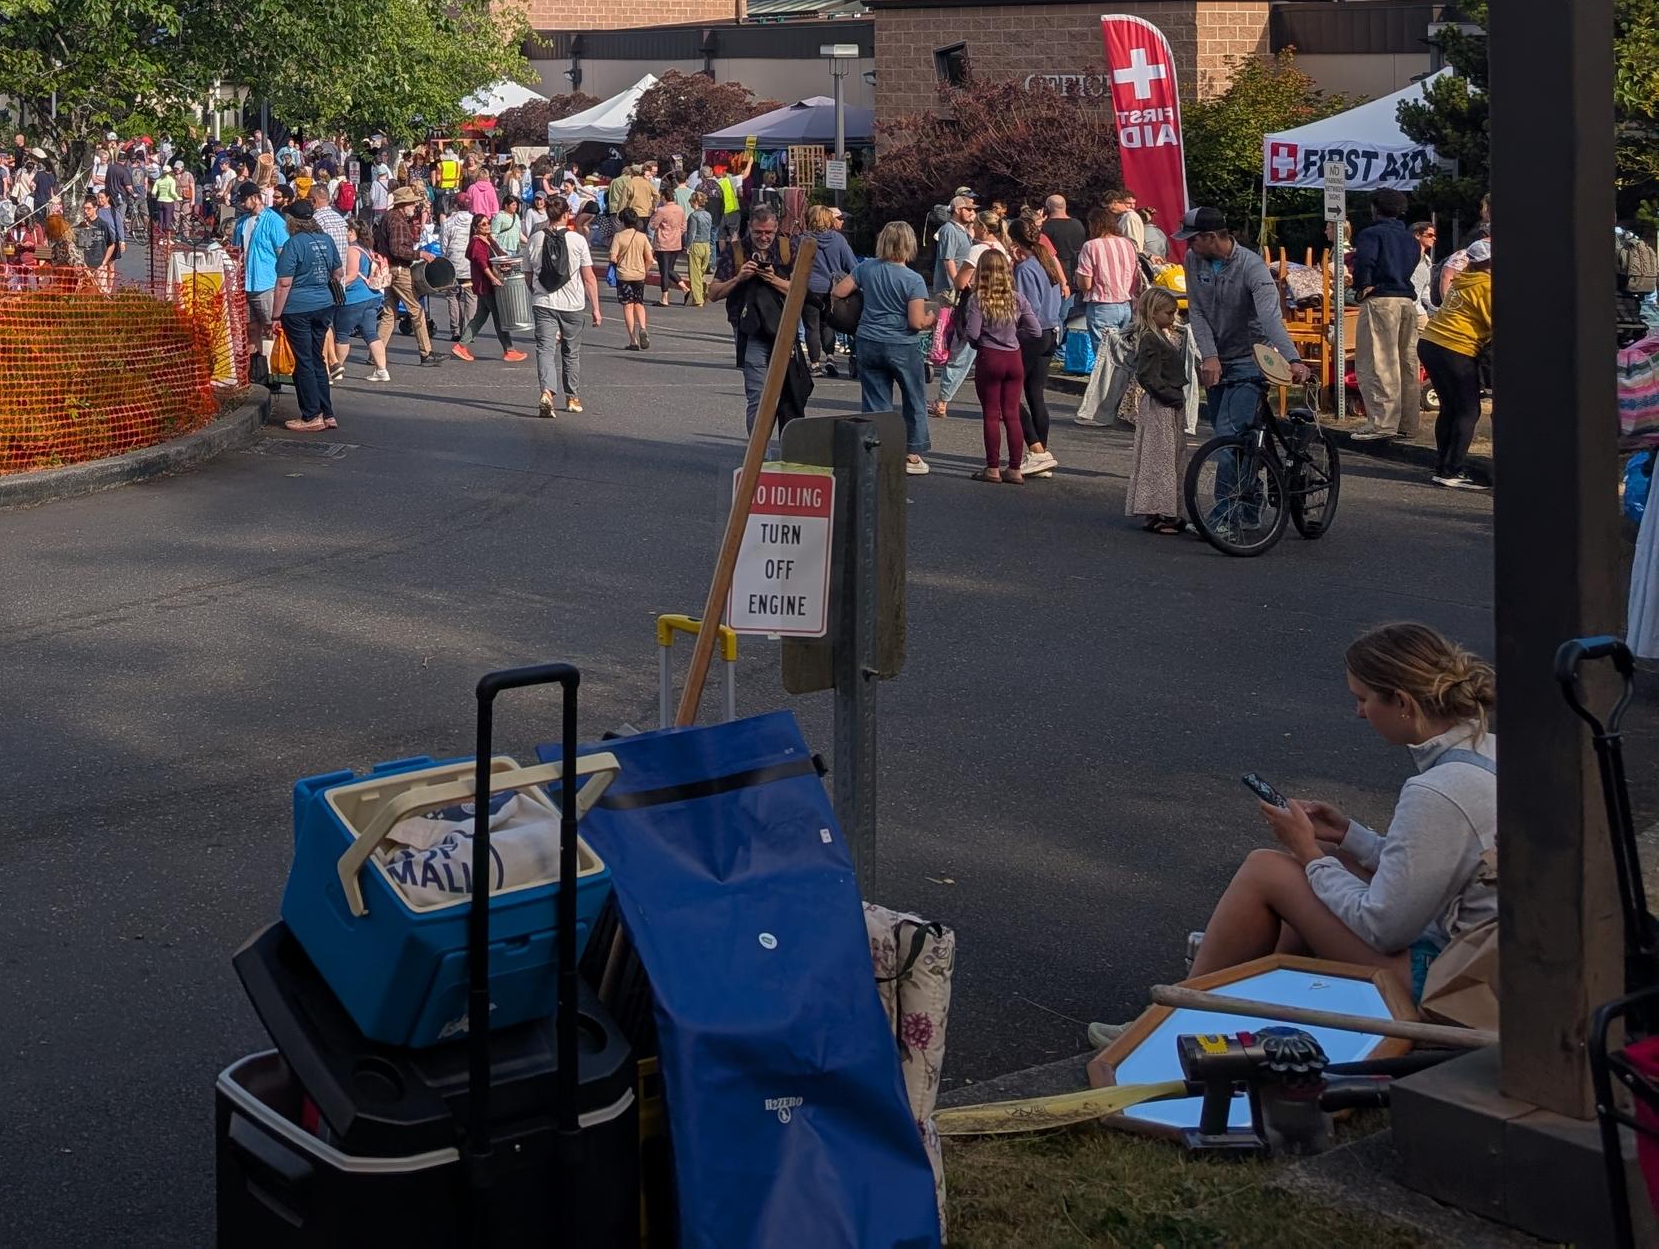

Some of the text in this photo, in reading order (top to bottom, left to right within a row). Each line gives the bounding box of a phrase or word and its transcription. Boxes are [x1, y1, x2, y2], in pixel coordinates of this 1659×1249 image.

[1329, 165, 1340, 176] NO
[1378, 150, 1428, 181] AID
[771, 486, 822, 507] IDLING
[761, 523, 802, 545] TURN
[765, 559, 795, 579] OFF
[748, 594, 807, 616] ENGINE
